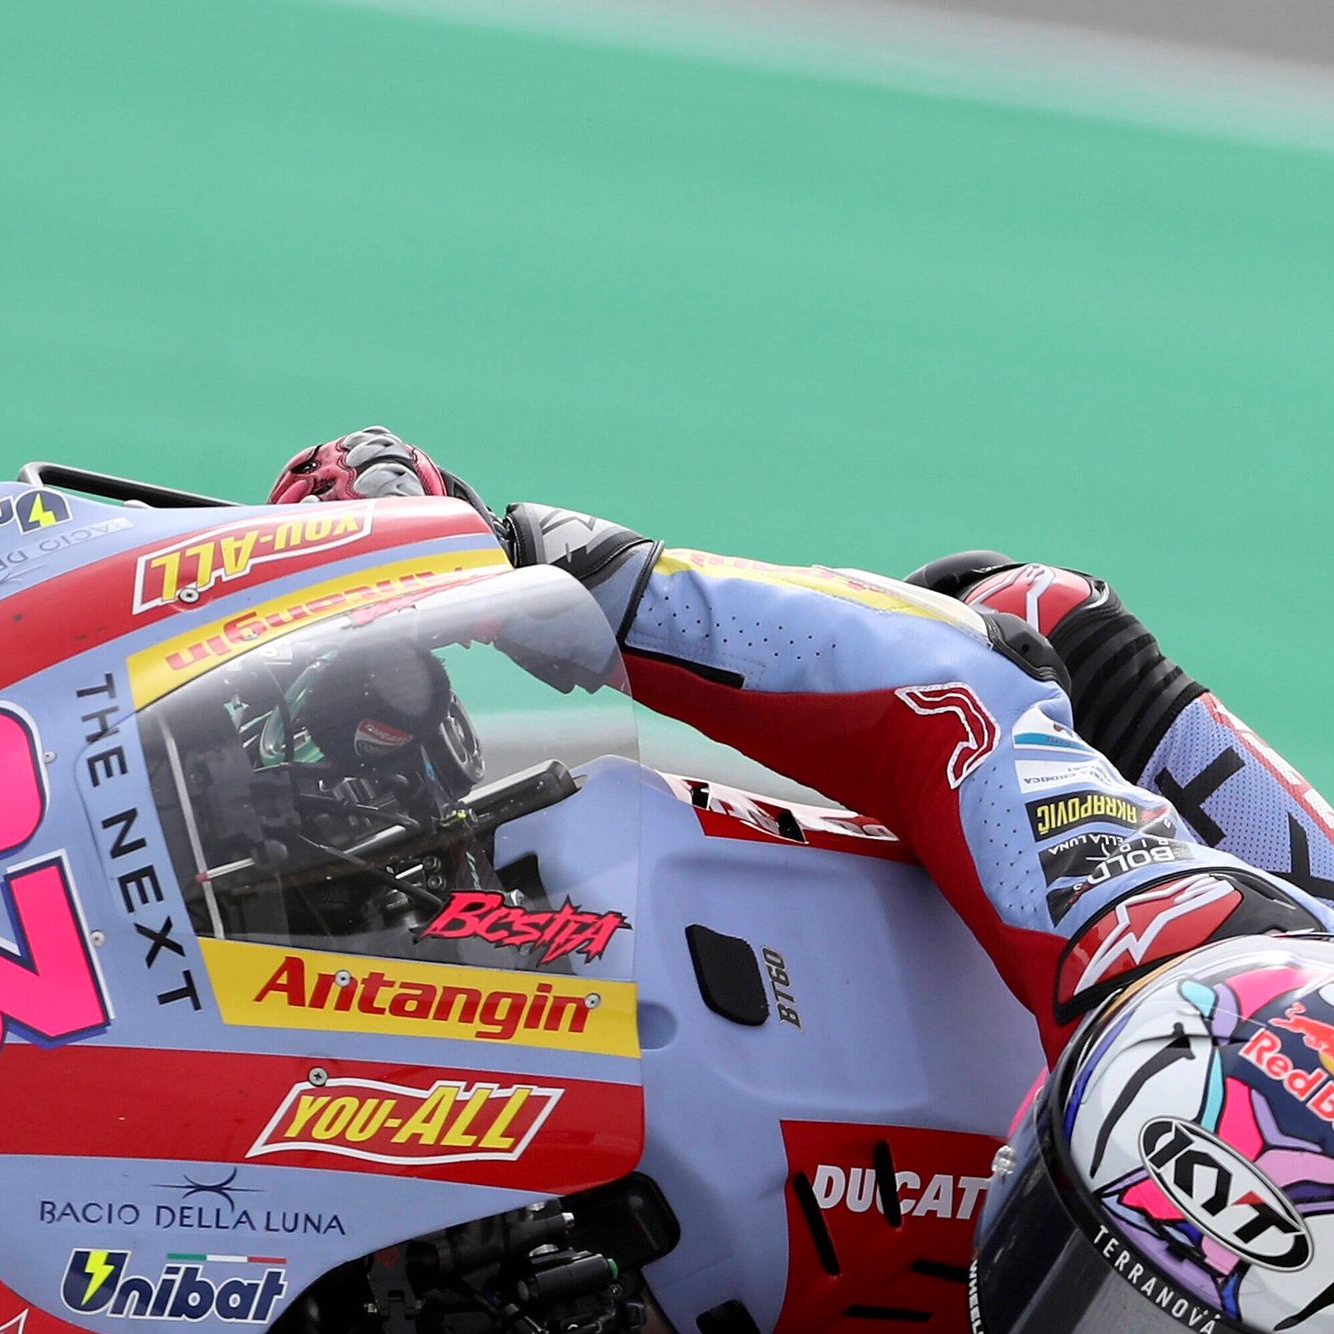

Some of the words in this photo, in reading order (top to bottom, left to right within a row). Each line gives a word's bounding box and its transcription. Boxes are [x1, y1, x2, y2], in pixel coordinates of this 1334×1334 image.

[151, 509, 363, 602] YOU-ALL
[76, 672, 129, 788] THE
[1048, 835, 1088, 855] LUNA
[101, 807, 203, 1012] NEXT
[253, 956, 590, 1040] Antangin
[1239, 1028, 1313, 1101] Red
[283, 1084, 534, 1150] YOU-ALL
[40, 1200, 139, 1225] BACIO
[157, 1206, 256, 1232] DELLA
[264, 1207, 346, 1236] LUNA
[813, 1164, 992, 1220] DUCAT
[1145, 1130, 1299, 1262] KYT
[60, 1248, 289, 1324] Unibat
